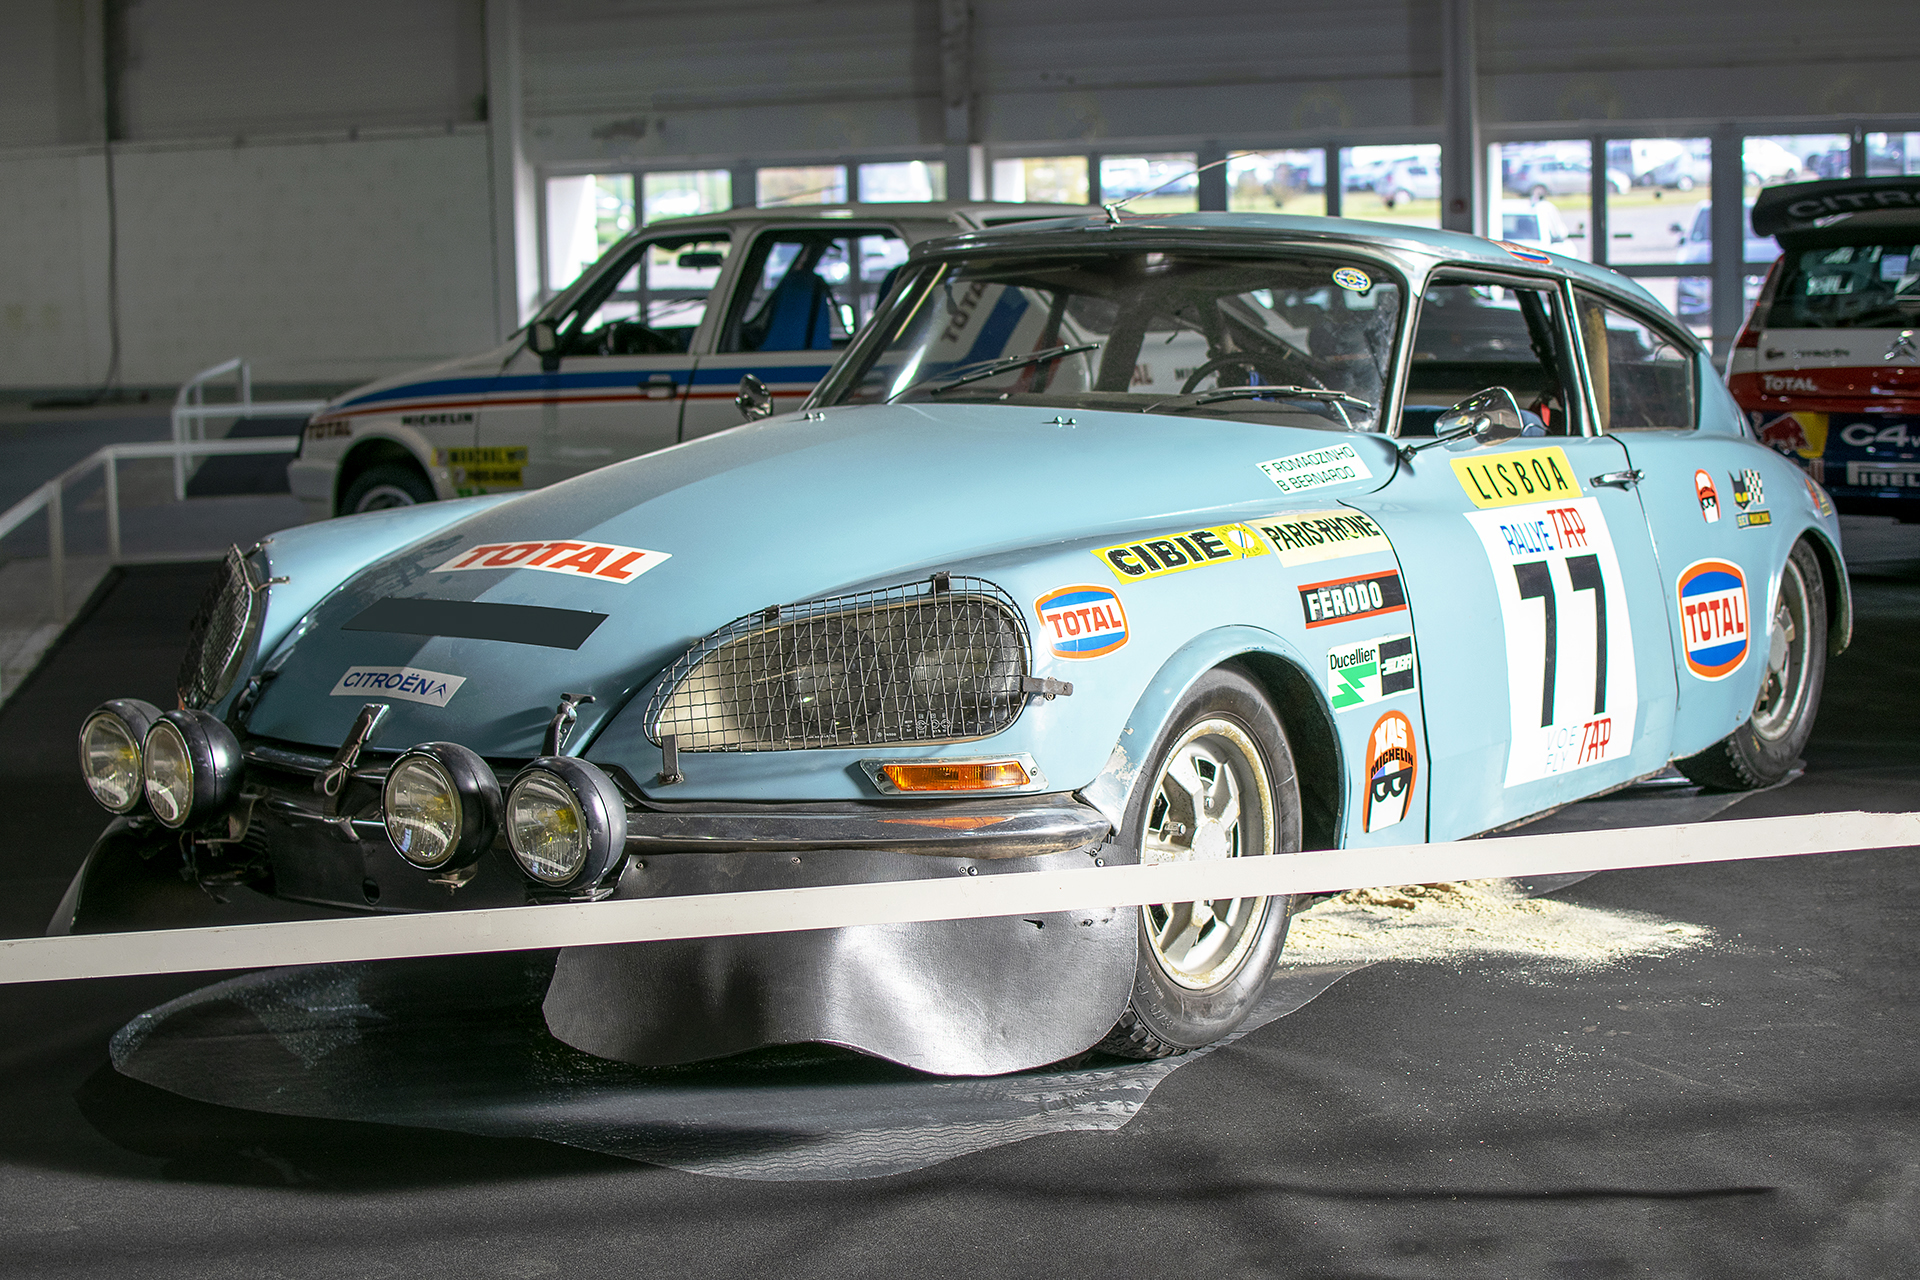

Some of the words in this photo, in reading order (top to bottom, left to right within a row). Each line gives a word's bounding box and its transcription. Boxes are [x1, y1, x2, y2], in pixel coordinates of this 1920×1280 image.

[1763, 375, 1818, 391] TOTAL
[1261, 465, 1271, 476] F
[1276, 479, 1290, 492] B
[1289, 466, 1355, 489] BERNARDO
[1467, 457, 1568, 499] LISBOA
[1500, 521, 1554, 555] RALLYE
[1546, 507, 1587, 549] TAP
[452, 543, 645, 580] TOTAL
[1306, 581, 1383, 621] FERODO
[1046, 605, 1122, 638] TOTAL
[1684, 596, 1744, 643] TOTAL
[1513, 553, 1608, 728] 77
[1329, 648, 1376, 670] Ducellier
[343, 672, 434, 696] CITROËN
[1577, 718, 1611, 765] TAP
[1371, 748, 1414, 779] MICHELIN
